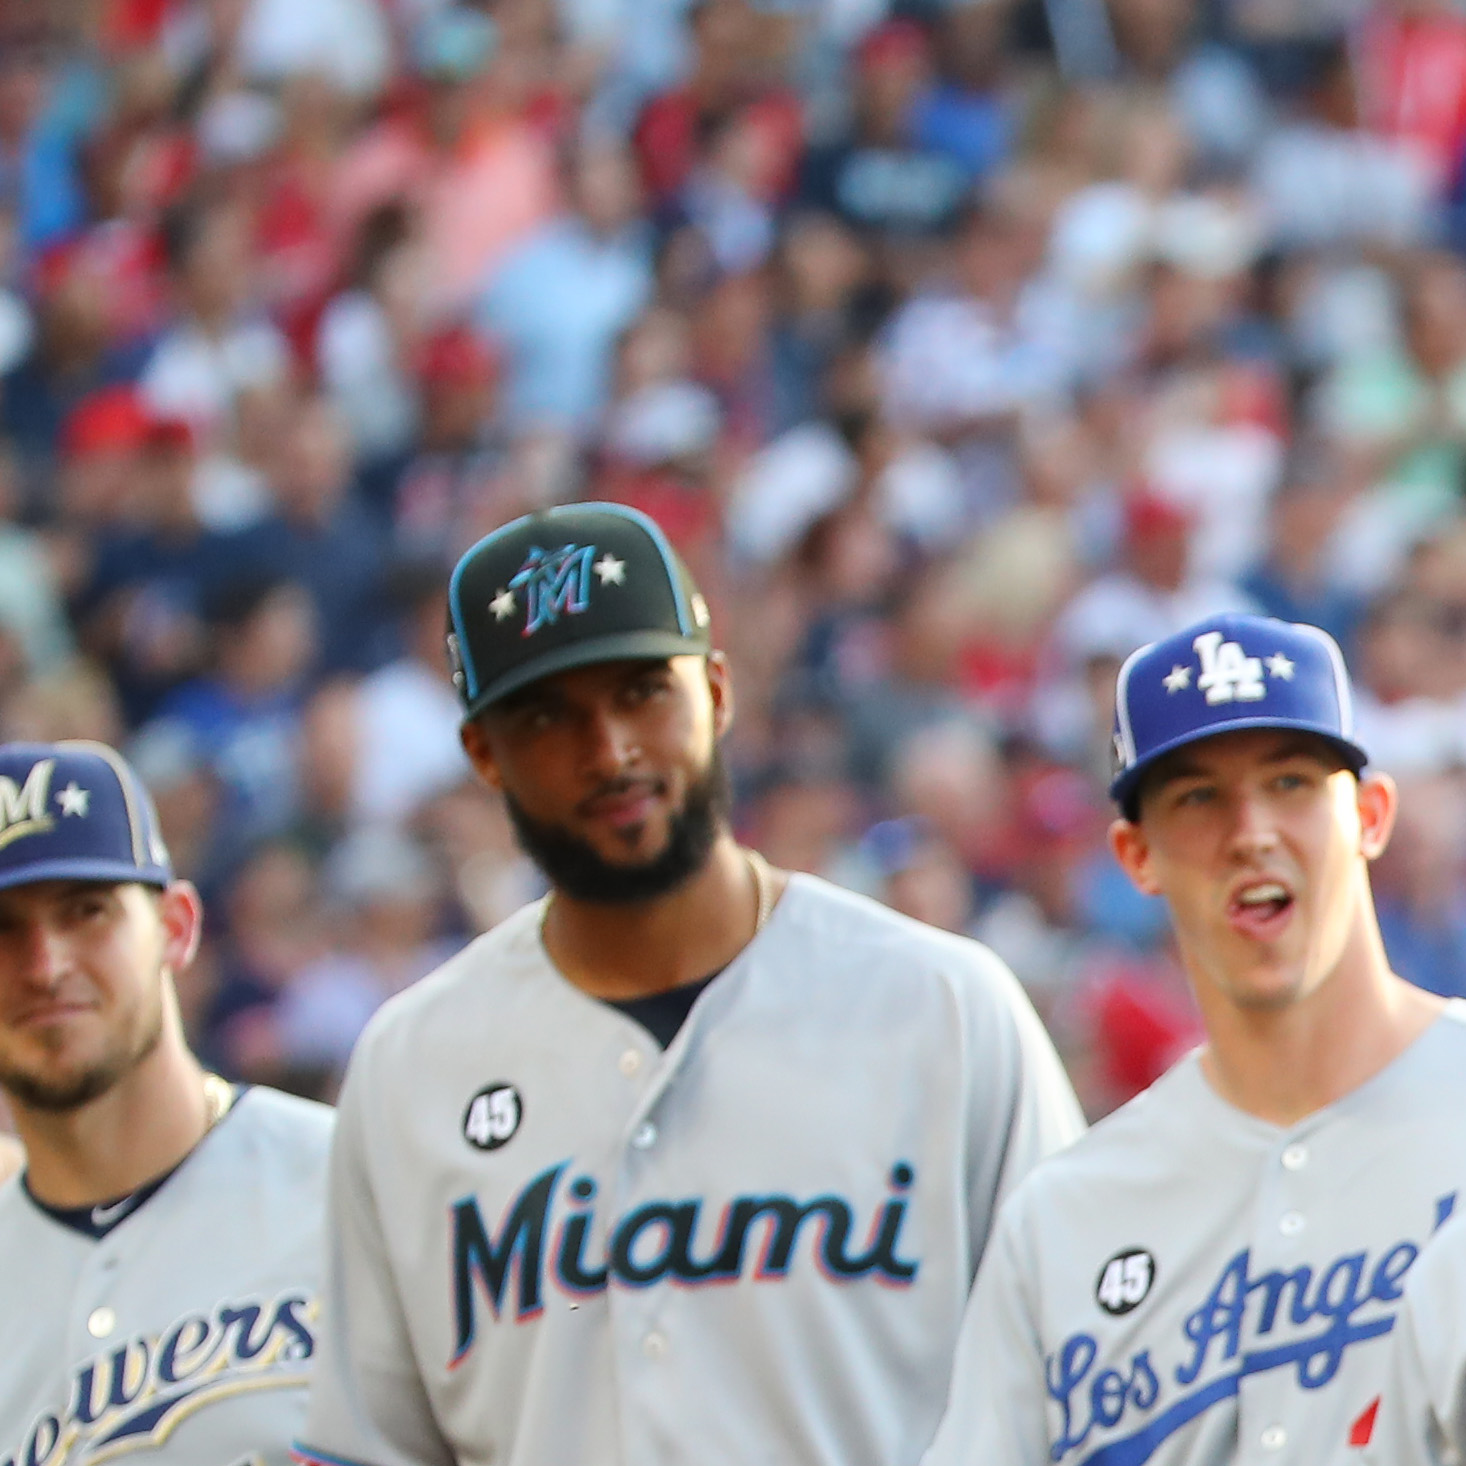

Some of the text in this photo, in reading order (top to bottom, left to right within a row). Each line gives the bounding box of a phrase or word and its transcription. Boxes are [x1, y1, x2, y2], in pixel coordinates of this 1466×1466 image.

[1192, 630, 1267, 707] LA
[464, 1084, 517, 1147] 45
[446, 1155, 923, 1371] Miami
[1097, 1250, 1151, 1309] 45
[1045, 1332, 1160, 1463] Los
